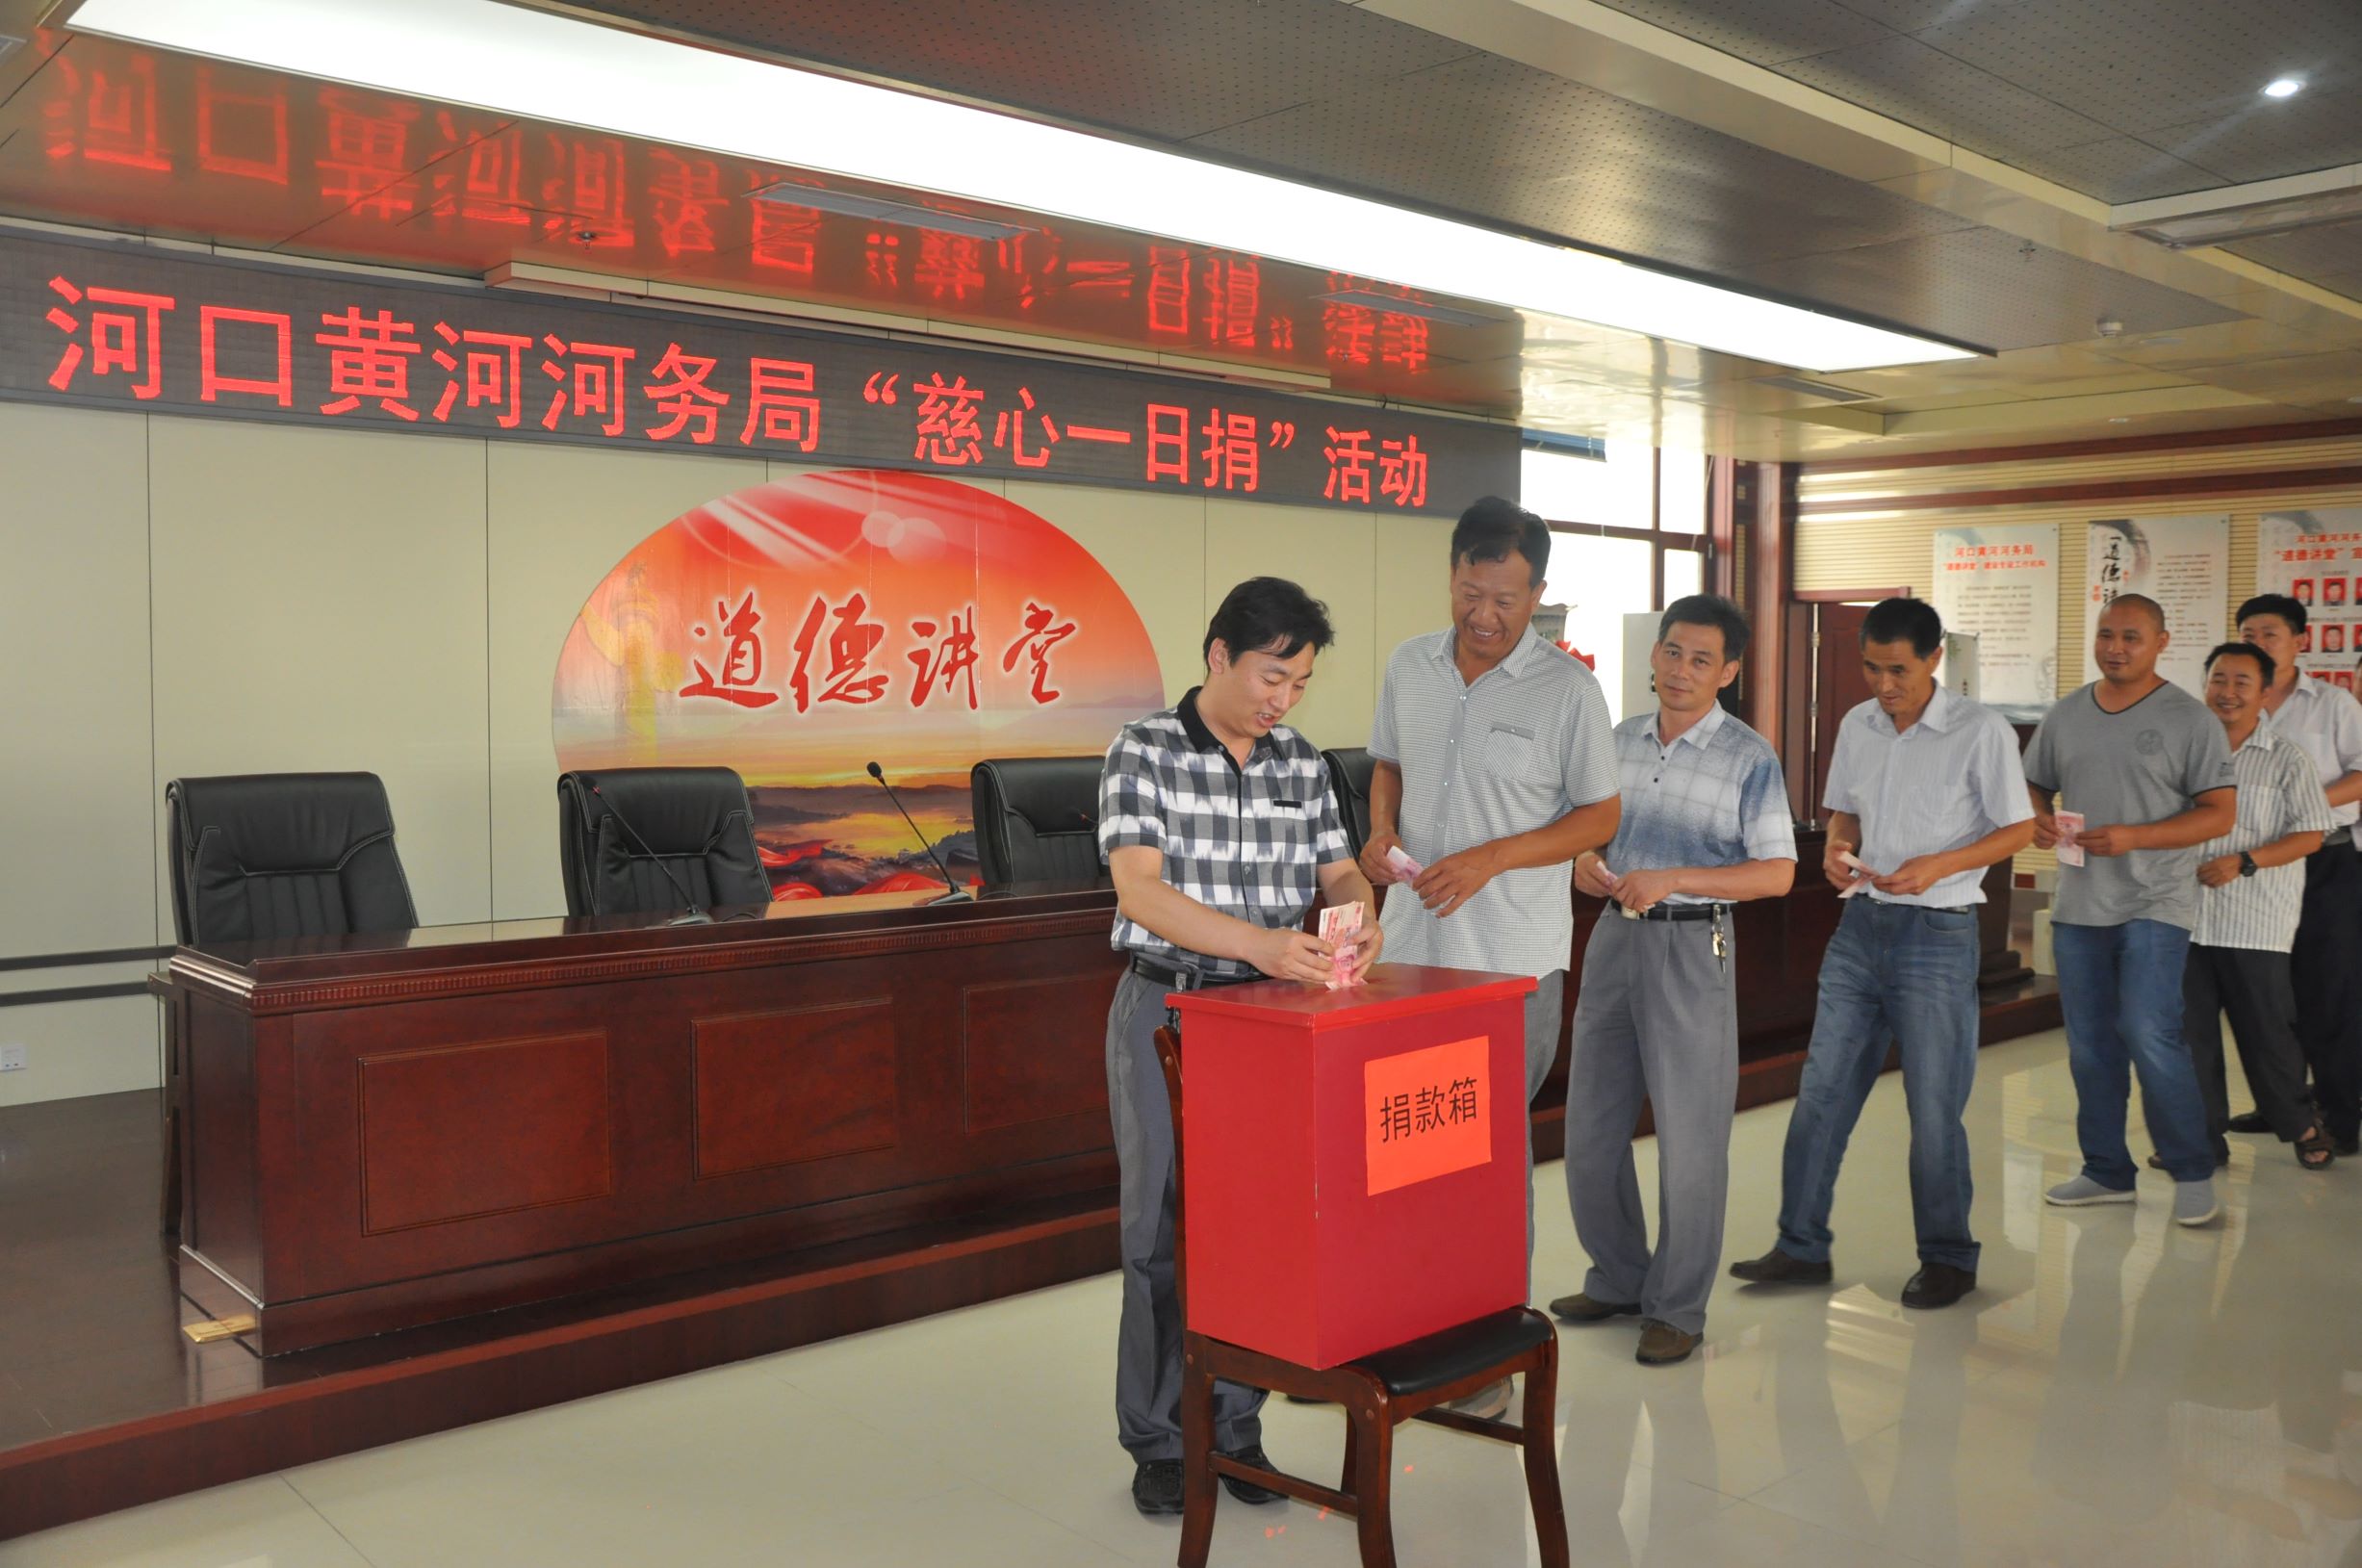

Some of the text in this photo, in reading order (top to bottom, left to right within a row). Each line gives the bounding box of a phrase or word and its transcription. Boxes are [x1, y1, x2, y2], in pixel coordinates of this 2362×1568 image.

[680, 592, 1076, 713] 道德讲堂
[1379, 1076, 1478, 1144] 捐款箱
